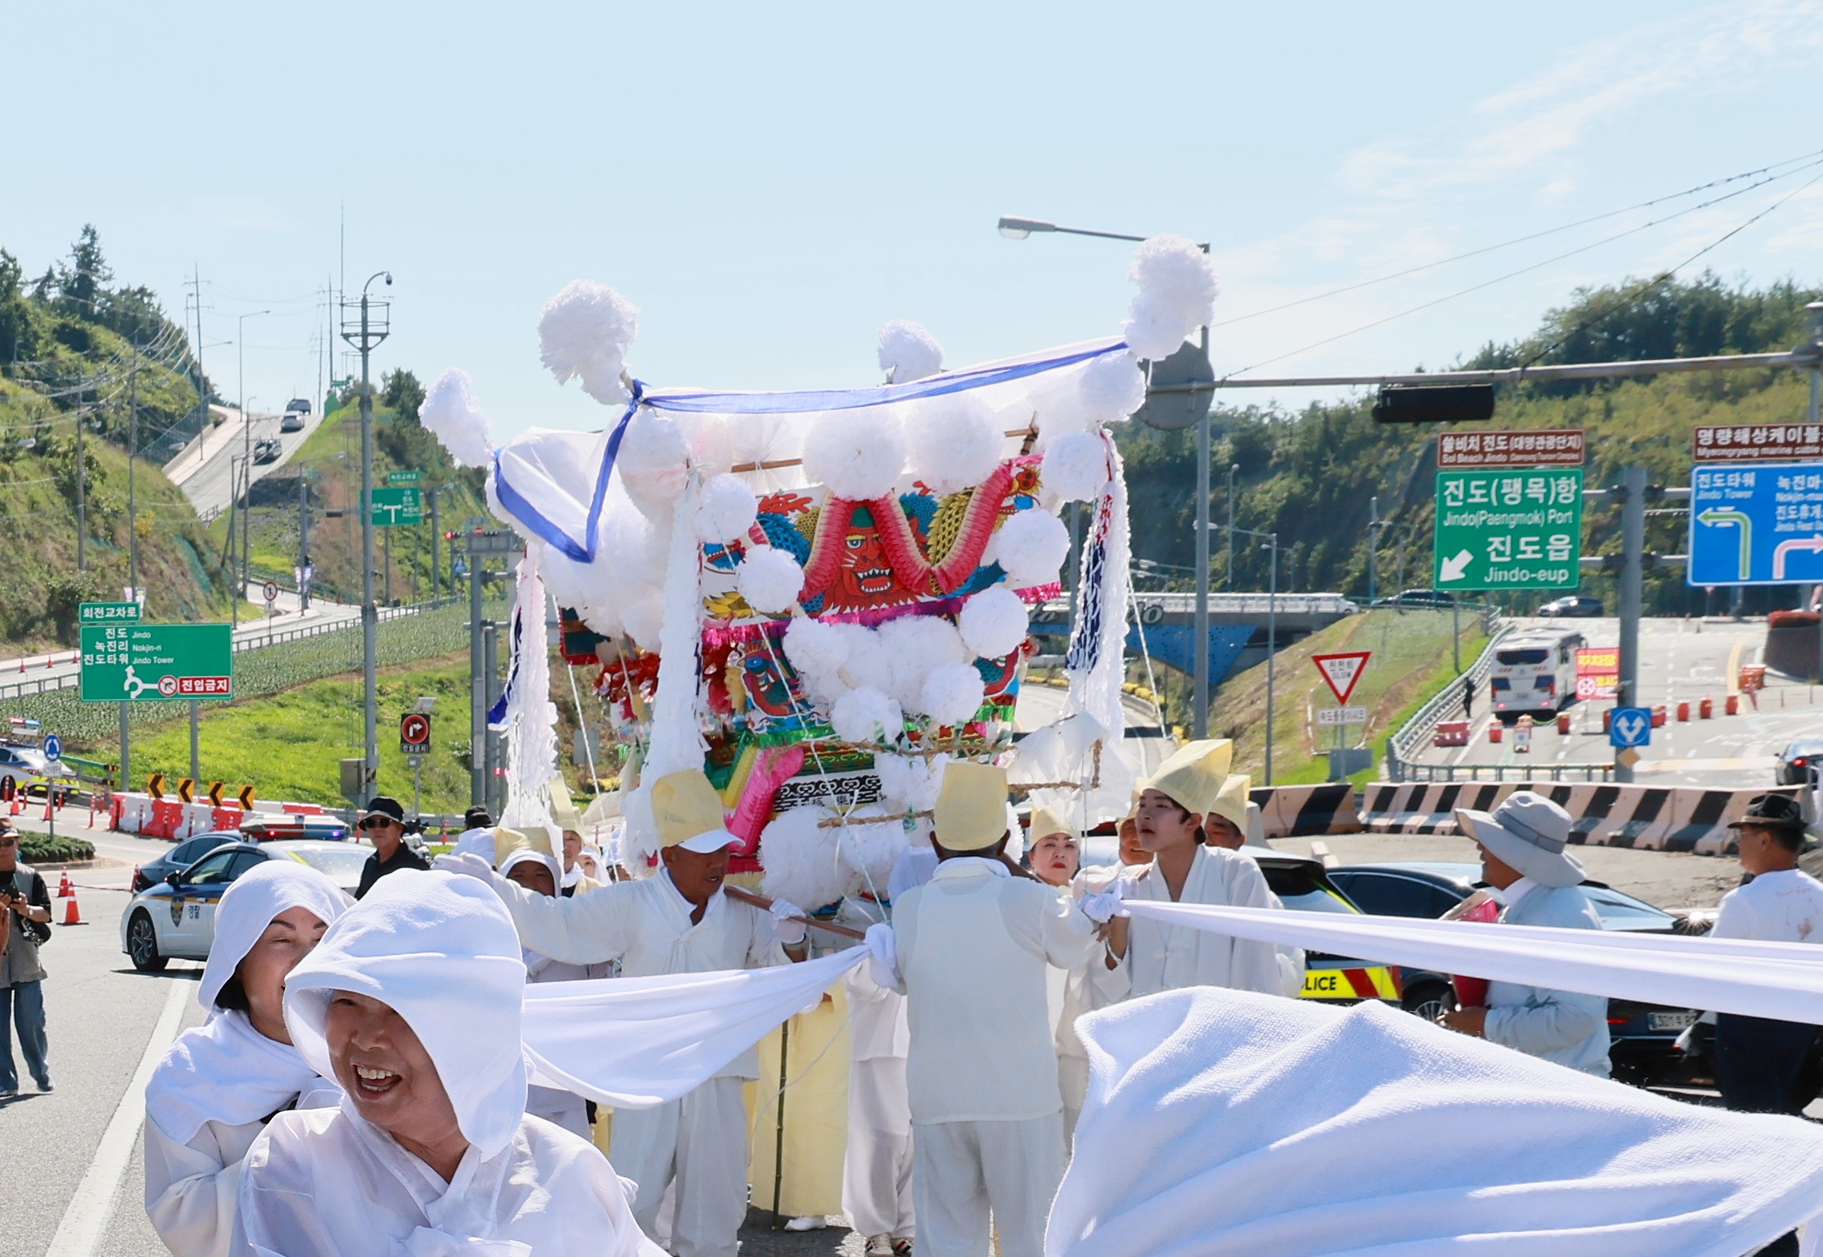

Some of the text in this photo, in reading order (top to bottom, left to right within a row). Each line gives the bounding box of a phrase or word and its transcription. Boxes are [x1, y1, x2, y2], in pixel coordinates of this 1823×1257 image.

[1483, 435, 1509, 451] 진도
[1697, 426, 1823, 445] 명량해상케이블
[1698, 472, 1756, 488] 진도타워
[1777, 475, 1823, 490] 녹진마
[1443, 476, 1578, 507] 진도(팽목)항
[1443, 509, 1573, 528] Jindo(Paengmok) Port
[1776, 504, 1823, 520] 진도휴게
[1486, 534, 1573, 562] 진도읍
[1484, 567, 1569, 584] Jindo-eup
[83, 606, 137, 619] 회전교차로
[105, 628, 127, 639] 진도
[132, 631, 151, 639] Jindo
[95, 640, 128, 652] 녹진리
[132, 643, 162, 653] Nokjin-ri
[83, 654, 129, 665] 진도타워
[132, 656, 174, 665] Jindo Tower
[181, 680, 228, 692] 진입금지
[189, 905, 200, 919] 경찰
[1301, 976, 1337, 991] LICE
